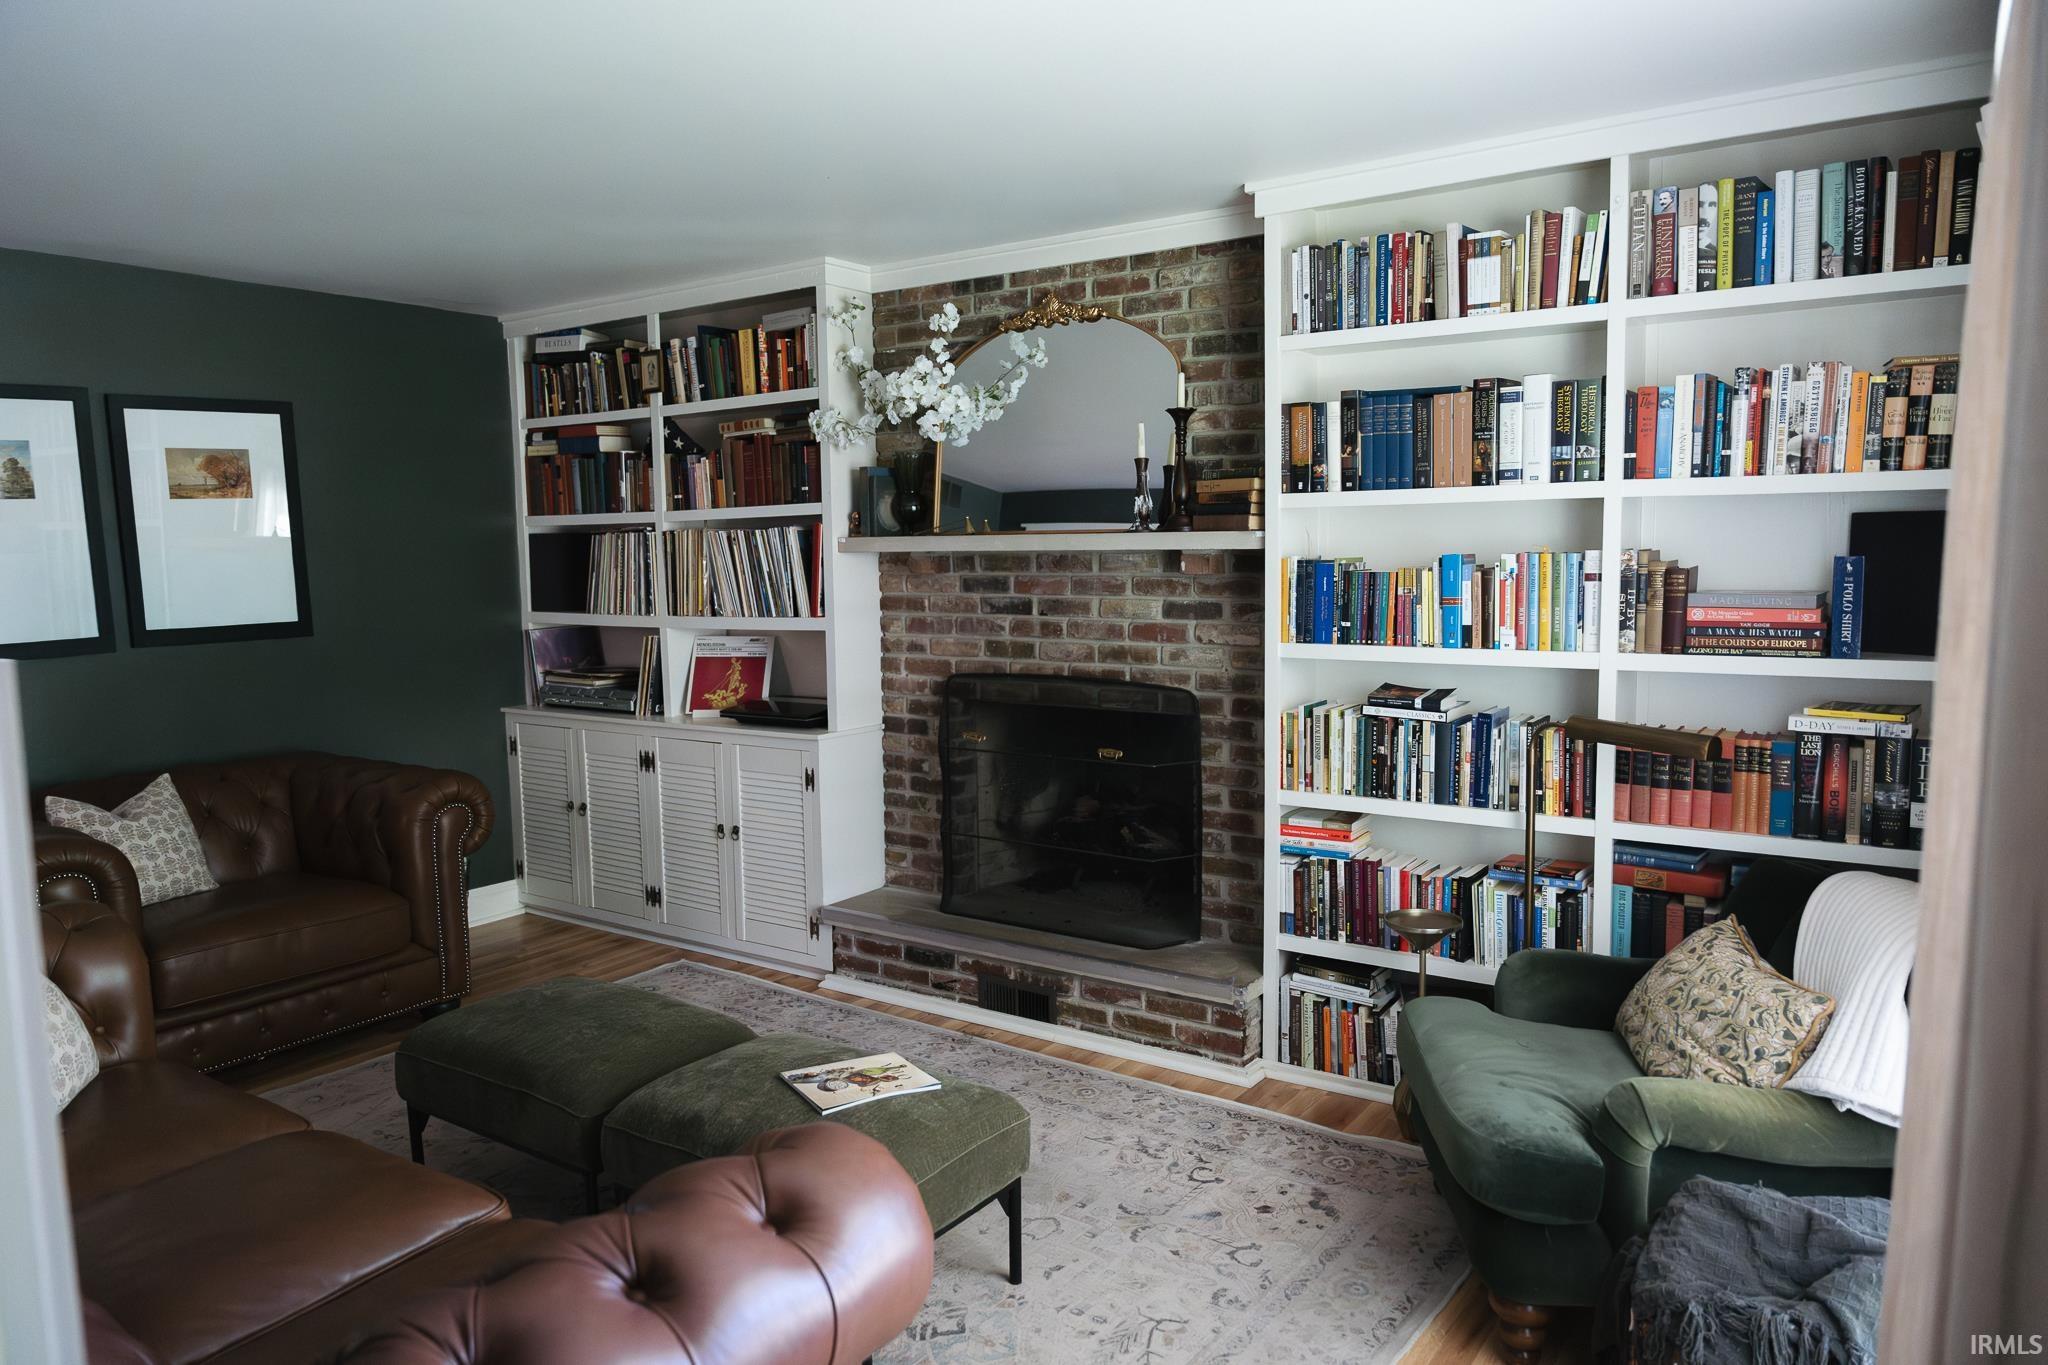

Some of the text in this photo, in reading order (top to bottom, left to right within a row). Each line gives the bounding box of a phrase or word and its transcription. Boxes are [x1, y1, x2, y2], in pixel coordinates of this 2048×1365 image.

[1722, 210, 1730, 220] THE
[1833, 182, 1843, 246] The Strangest Man
[1853, 167, 1866, 257] BOBBY KENNEDY
[1954, 178, 1973, 235] VAN CLIBURN
[1632, 203, 1647, 252] TITAN
[1722, 240, 1729, 248] OF
[1654, 246, 1662, 280] ISAACSON
[1660, 218, 1673, 278] EINSTEIN
[1347, 279, 1355, 294] GOD
[1782, 366, 1790, 391] STEPHEN
[1474, 400, 1482, 429] Gospels
[1487, 390, 1496, 428] Dictionary
[1556, 389, 1564, 432] THEOLOGY
[1564, 385, 1572, 434] SYSTEMATIC
[1580, 387, 1588, 433] THEOLOGY
[1588, 385, 1596, 436] HISTORICAL
[1778, 398, 1787, 424] AMBROSE
[1809, 380, 1820, 433] GETTYSBURG
[1678, 434, 1687, 467] ANARCHY
[1626, 590, 1636, 628] IF BY
[1710, 596, 1792, 606] MADE LIVING
[1841, 583, 1854, 643] POLO SHIRT
[1771, 640, 1807, 648] EUROPE
[1406, 712, 1436, 720] CLASSICS
[1794, 720, 1834, 730] D-DAY
[1800, 748, 1821, 756] LION
[1802, 734, 1820, 742] THE
[1680, 774, 1692, 782] Fate
[1831, 744, 1840, 788] CHURCHILL'S
[1885, 740, 1896, 782] Roosevelt
[1618, 890, 1626, 902] ERIC
